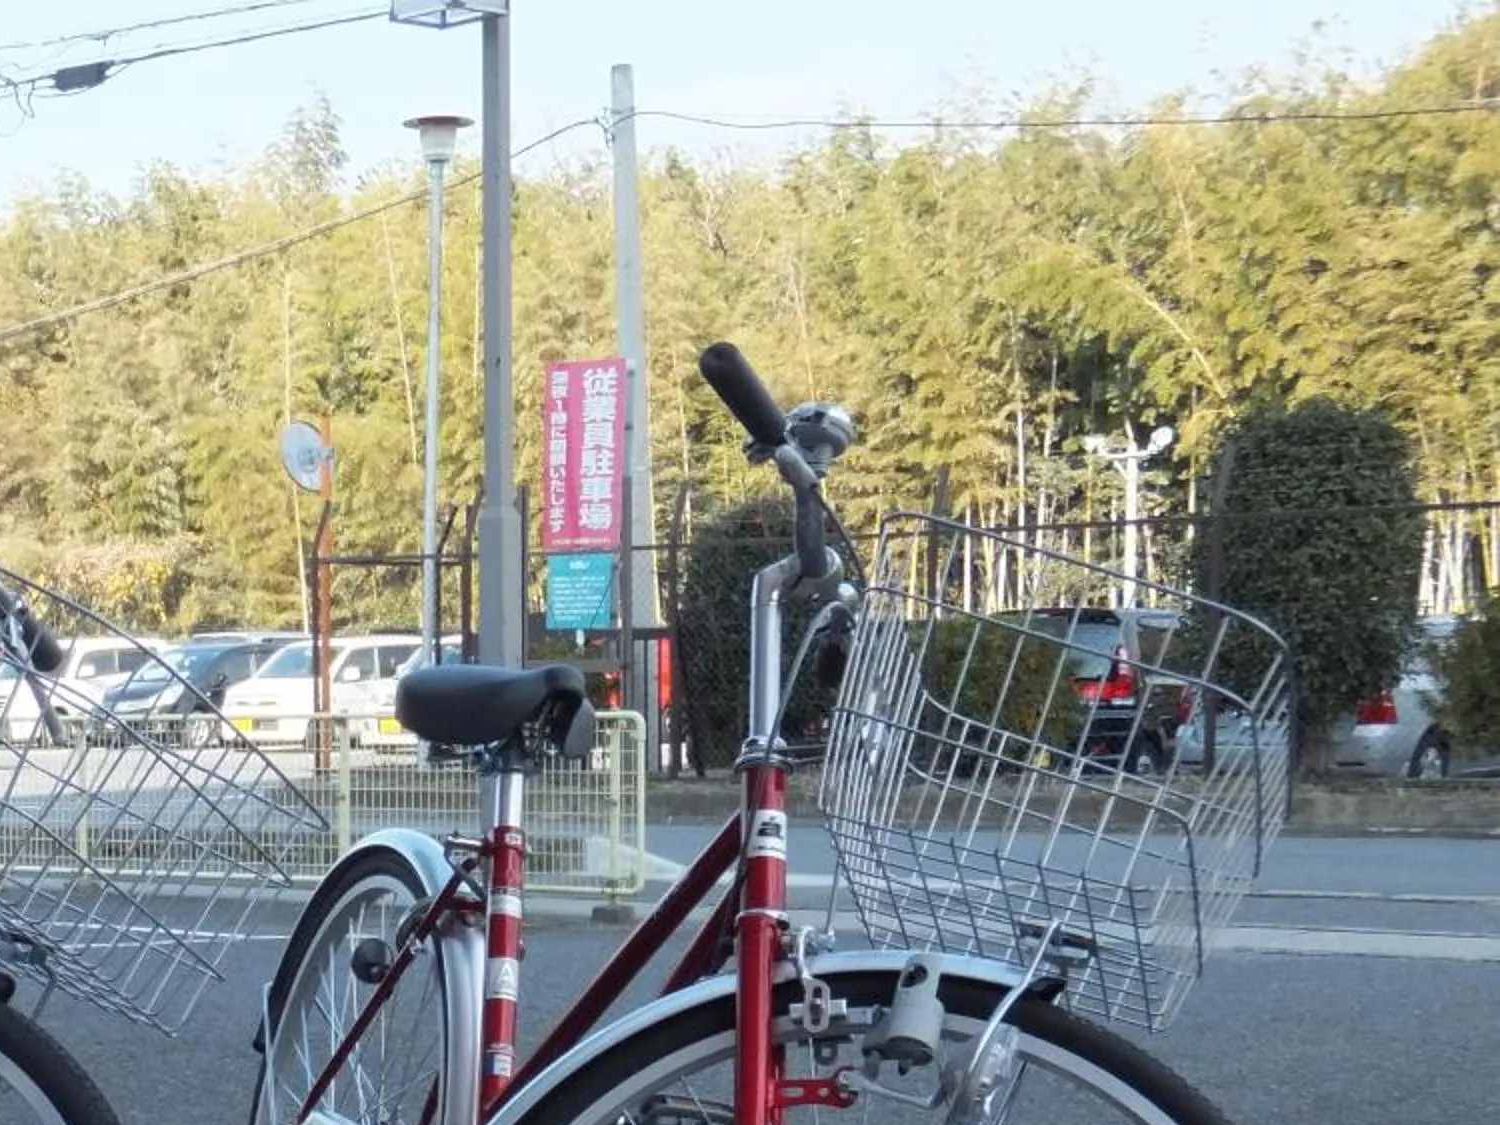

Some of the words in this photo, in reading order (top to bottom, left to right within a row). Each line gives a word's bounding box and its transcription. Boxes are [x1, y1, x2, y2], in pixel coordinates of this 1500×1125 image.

[578, 366, 618, 530] 従業員駐車場
